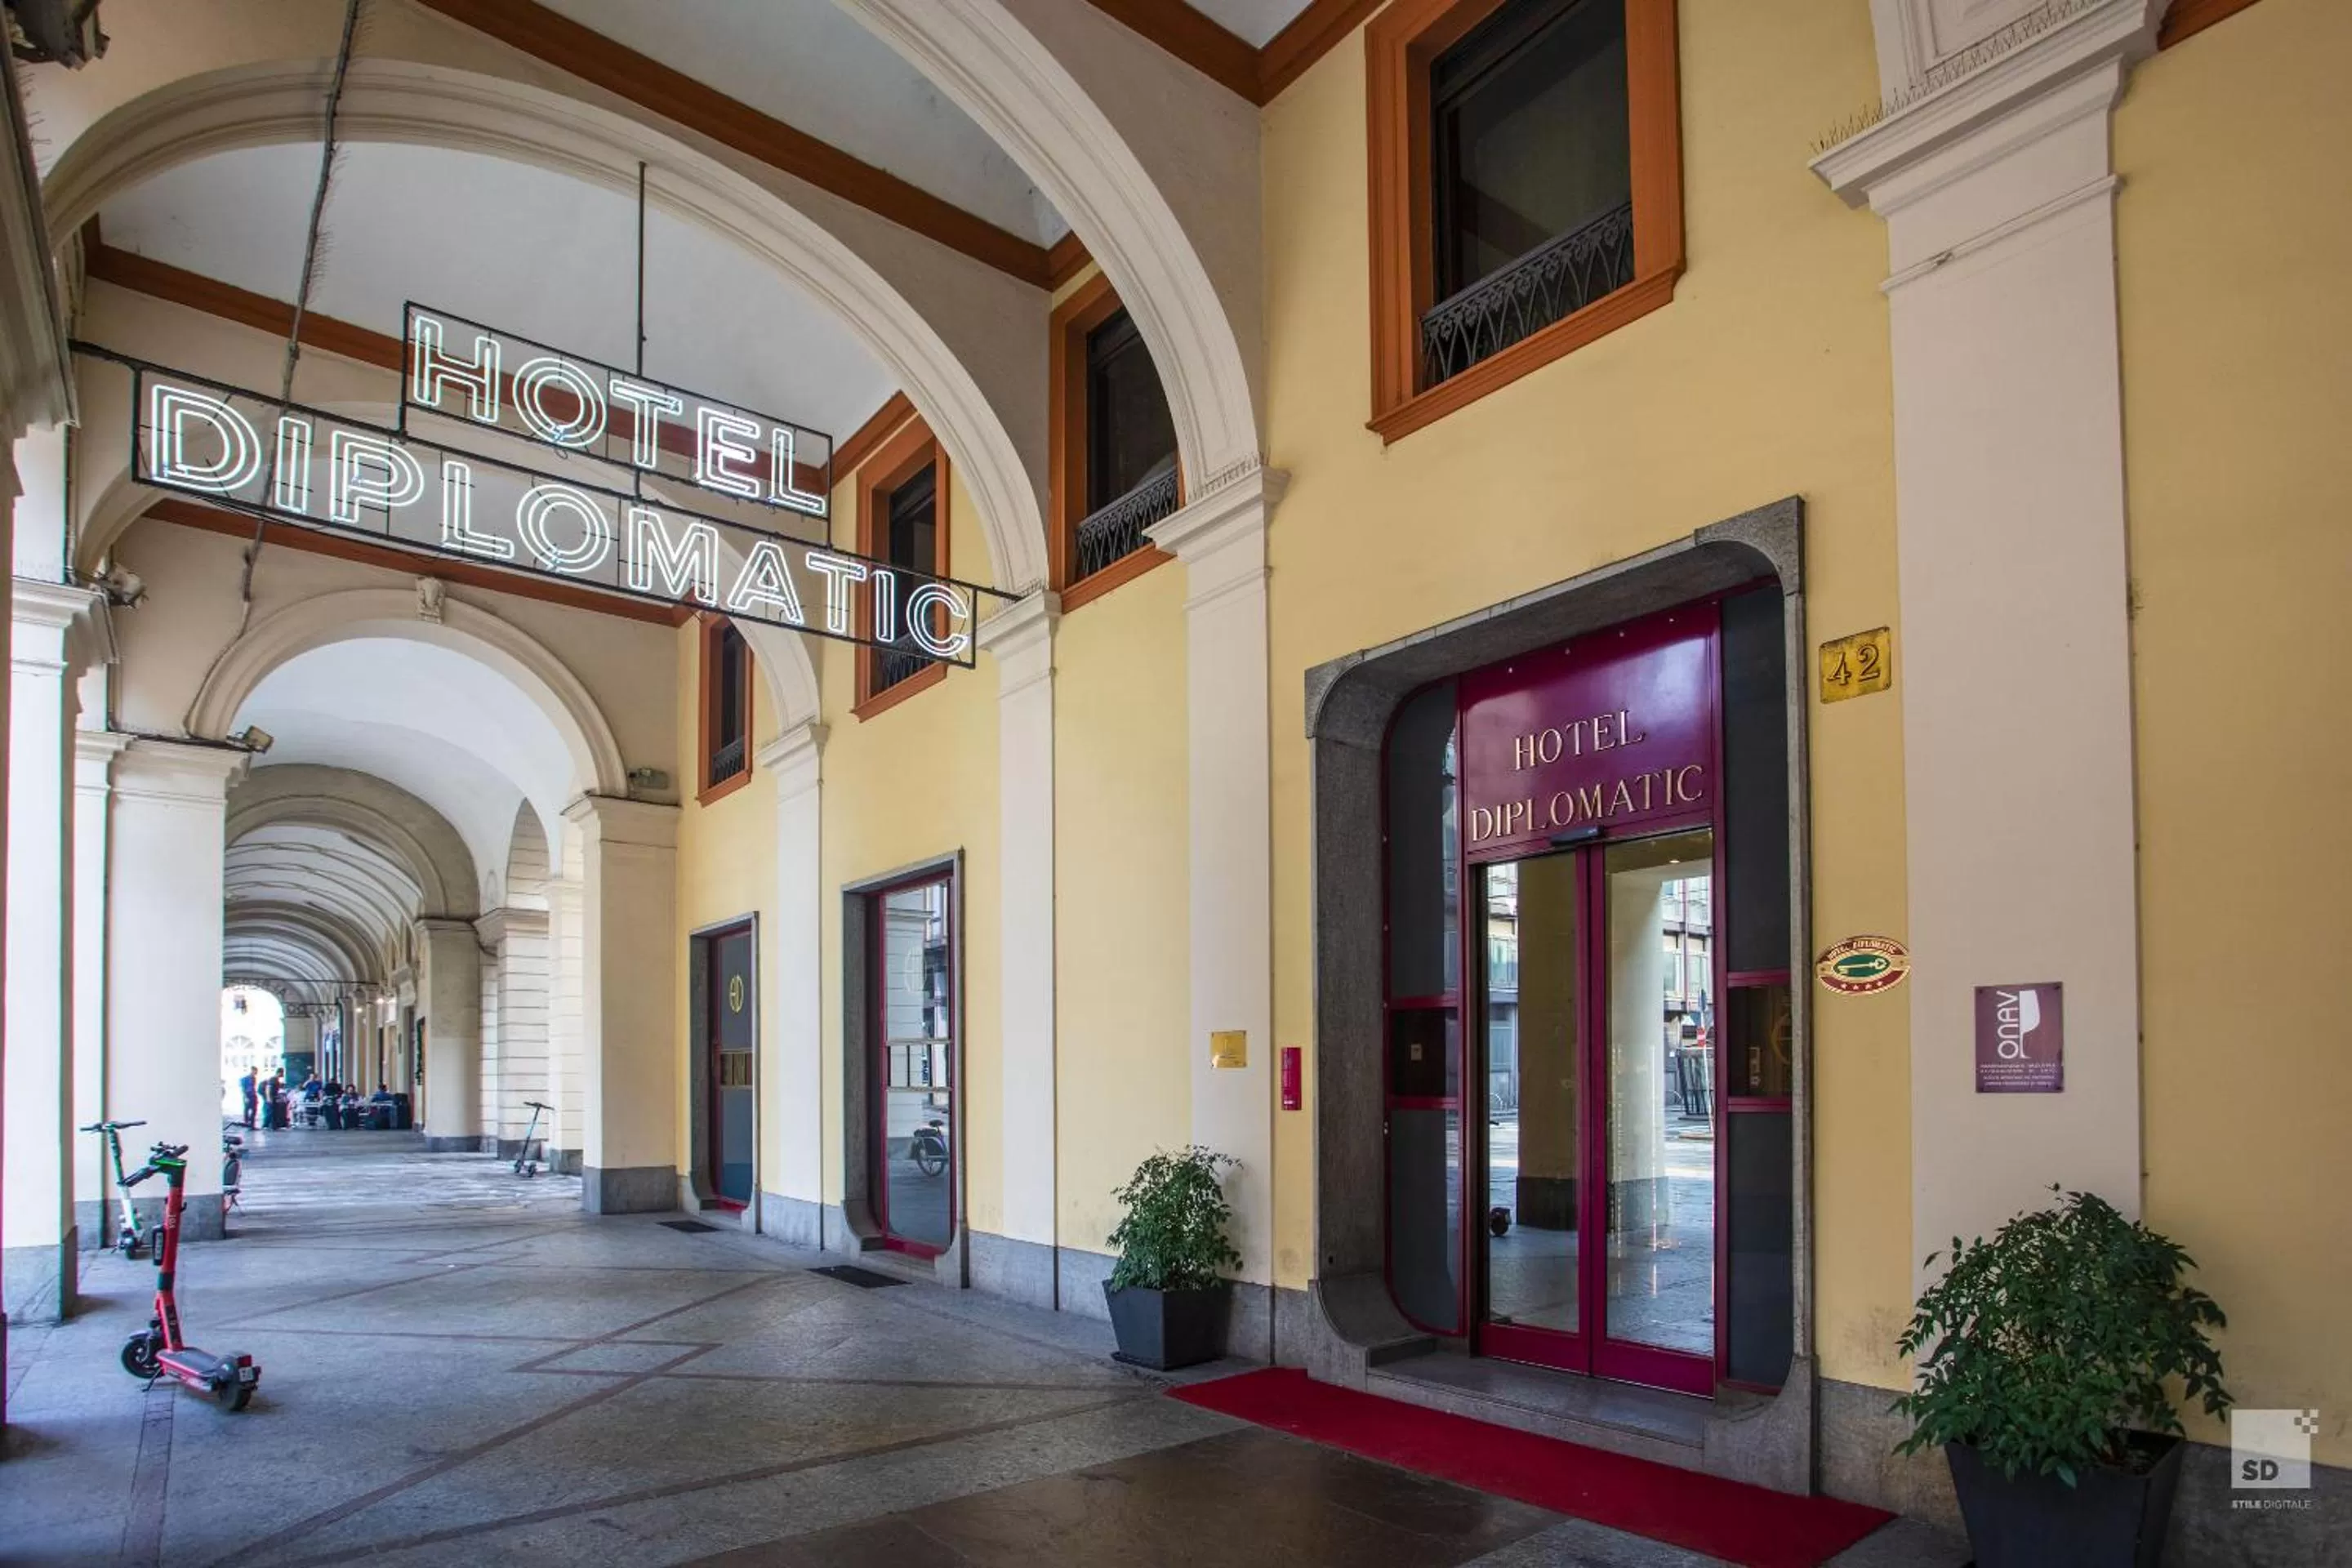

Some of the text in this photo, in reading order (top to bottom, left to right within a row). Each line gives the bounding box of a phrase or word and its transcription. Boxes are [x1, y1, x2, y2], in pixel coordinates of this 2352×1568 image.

[412, 315, 826, 514] HOTEL
[149, 384, 970, 656] DIPLOMATIC
[1826, 643, 1881, 686] 42
[1515, 709, 1646, 770] HOTEL
[1472, 764, 1704, 841] DIPLOMATIC
